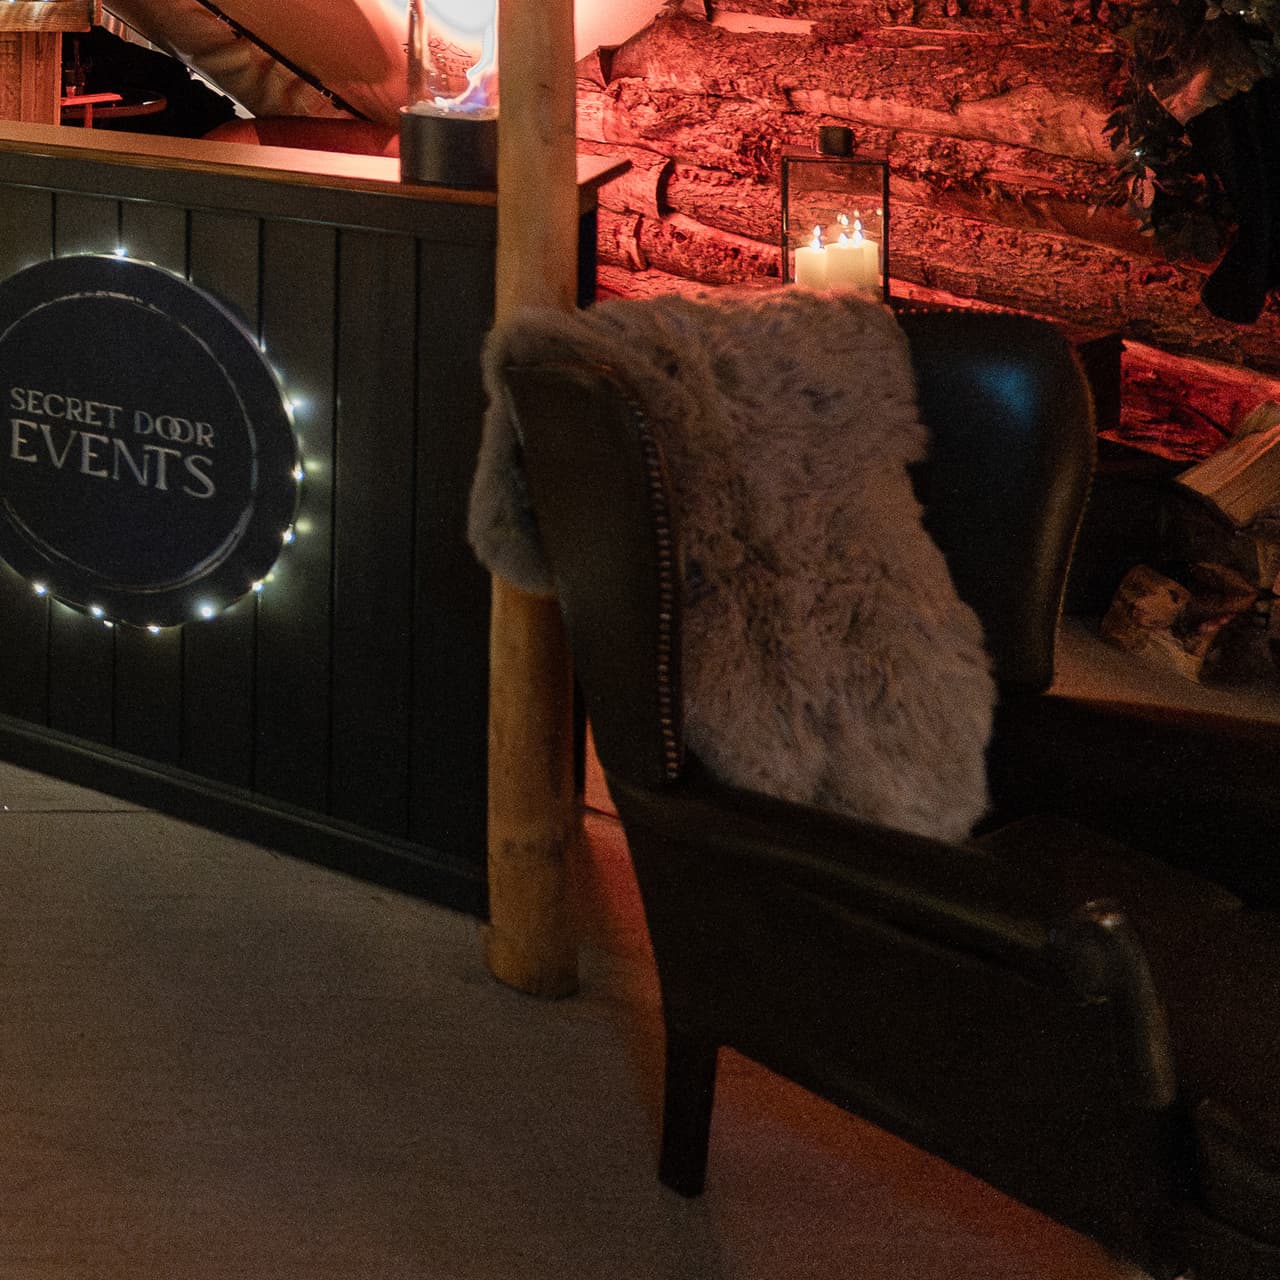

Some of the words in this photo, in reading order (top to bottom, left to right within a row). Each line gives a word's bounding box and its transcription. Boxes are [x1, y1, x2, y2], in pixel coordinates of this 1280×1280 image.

[10, 387, 123, 429] SECRET
[134, 410, 215, 448] DOOR
[11, 419, 216, 499] EVENTS
